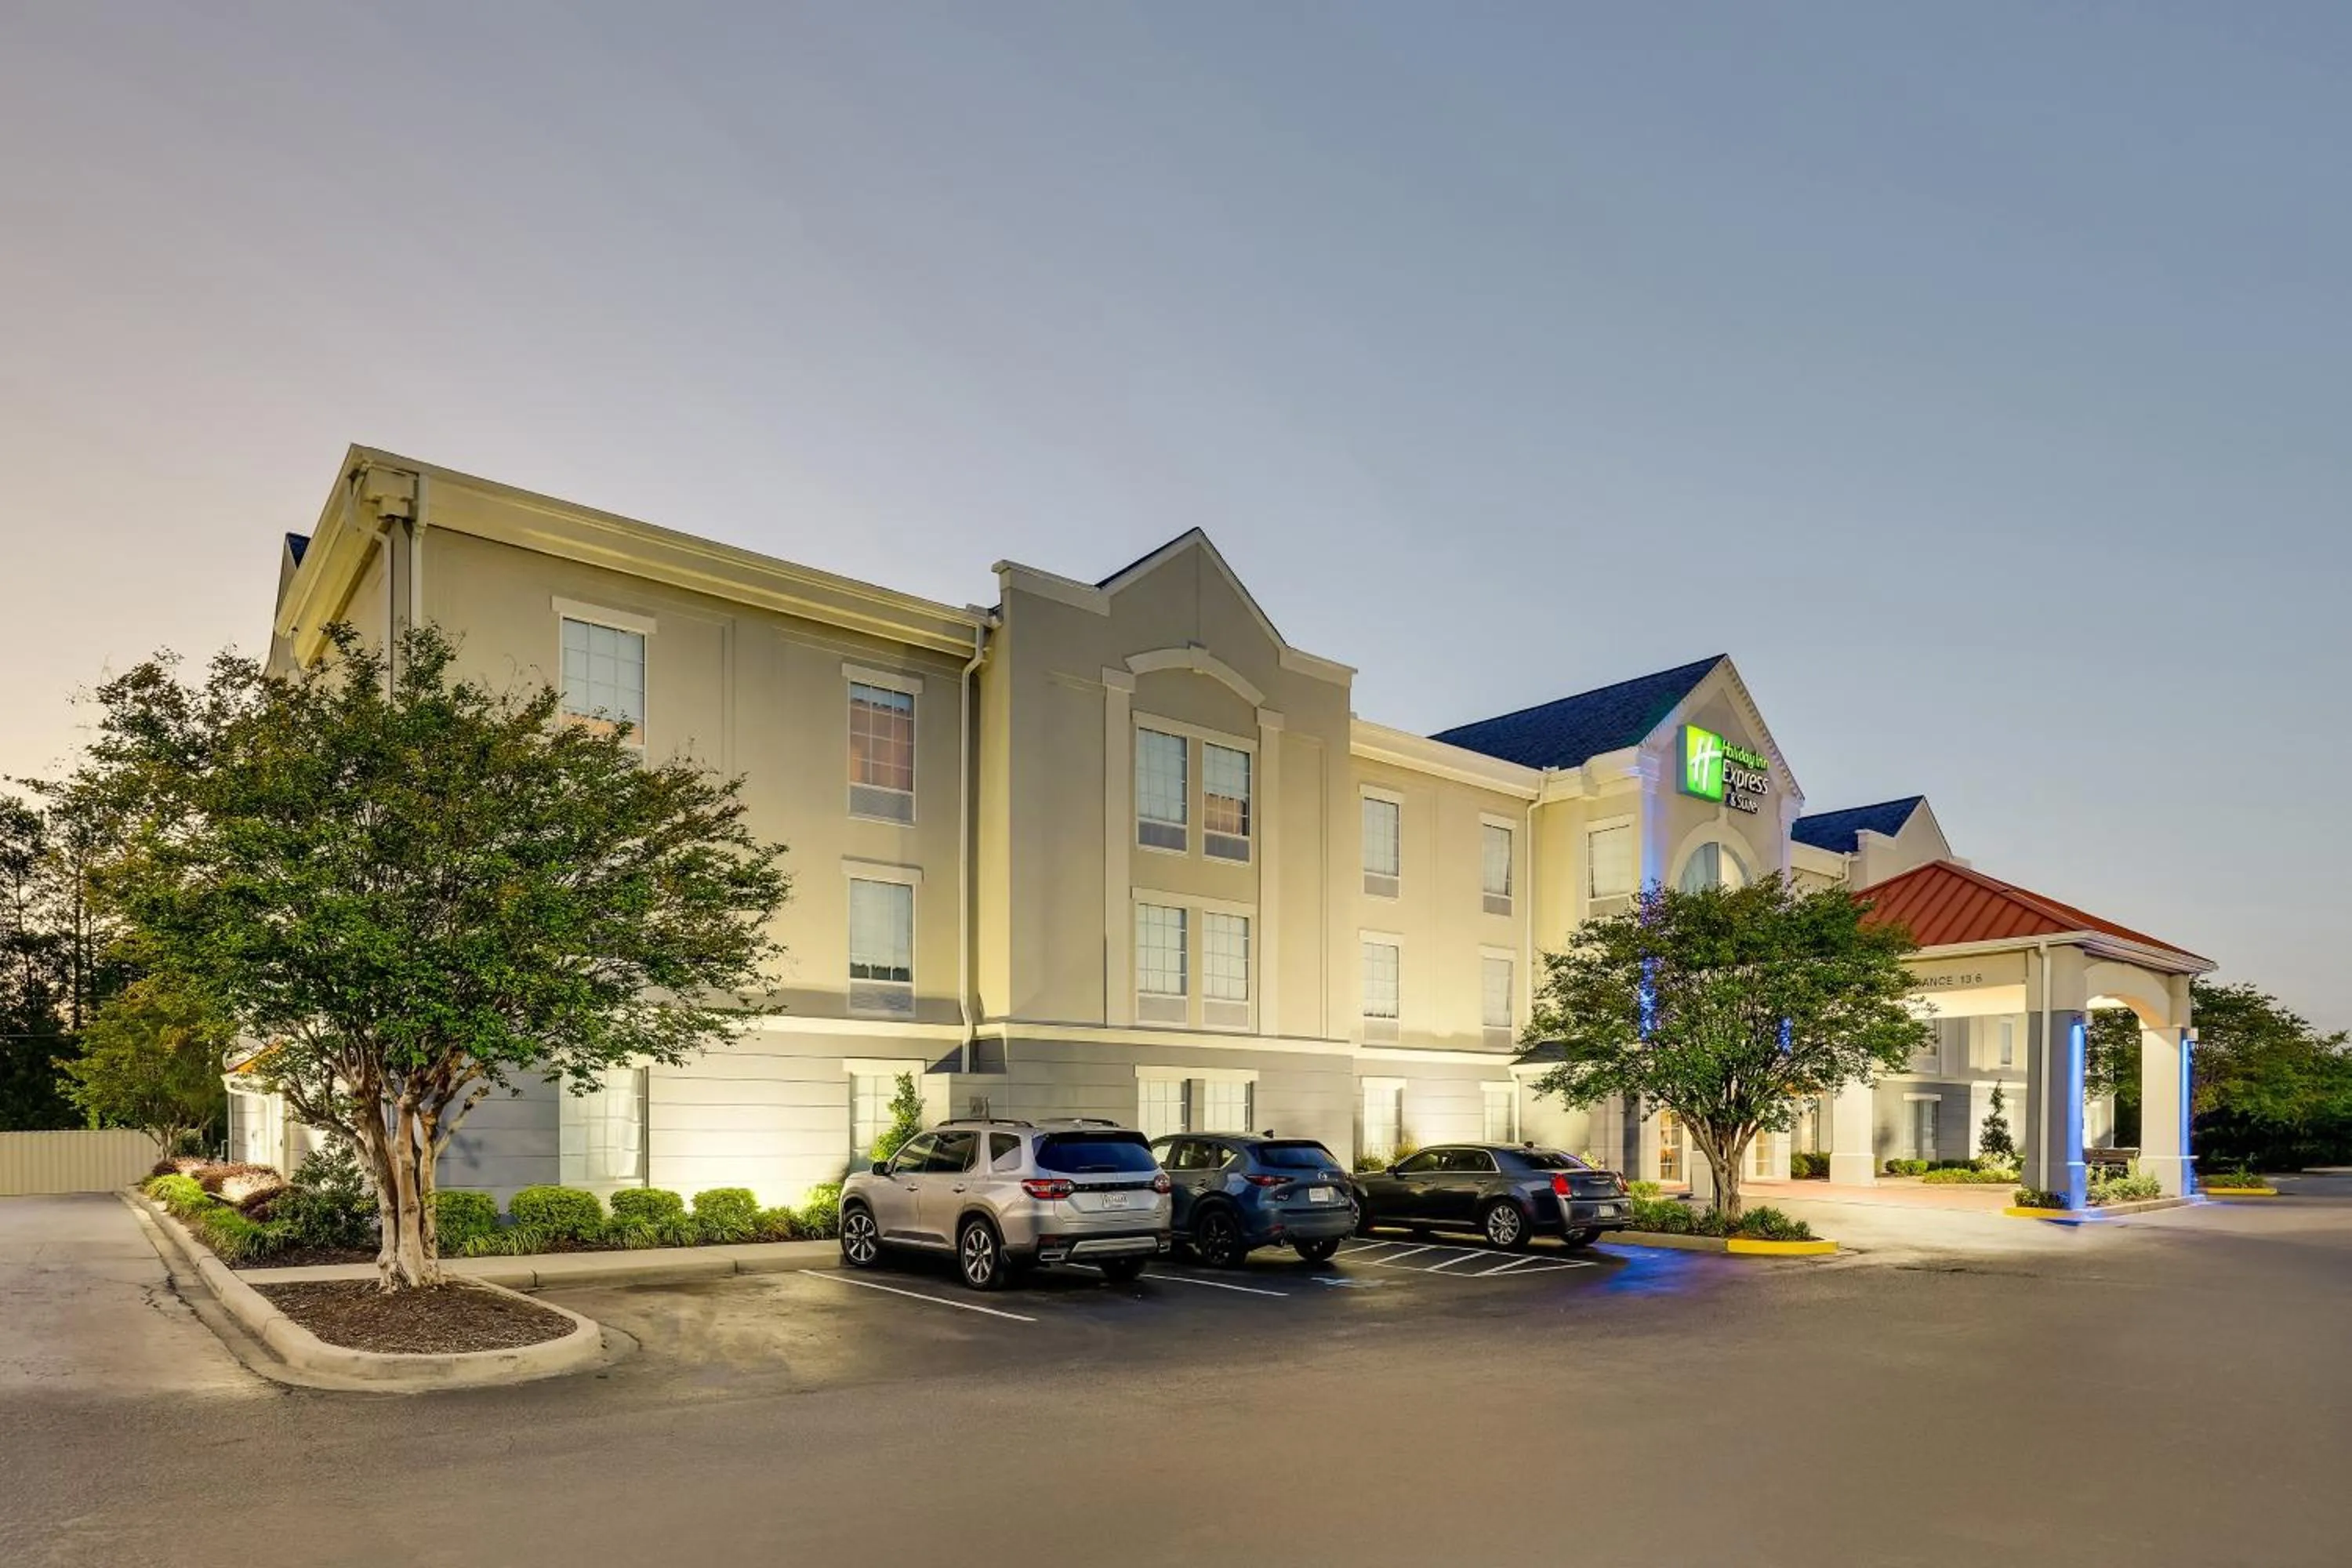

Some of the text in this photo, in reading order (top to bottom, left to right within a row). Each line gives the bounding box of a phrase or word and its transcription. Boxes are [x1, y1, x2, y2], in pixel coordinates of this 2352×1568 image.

[1722, 739, 1769, 769] Holiday Inn
[1722, 759, 1769, 794] Express
